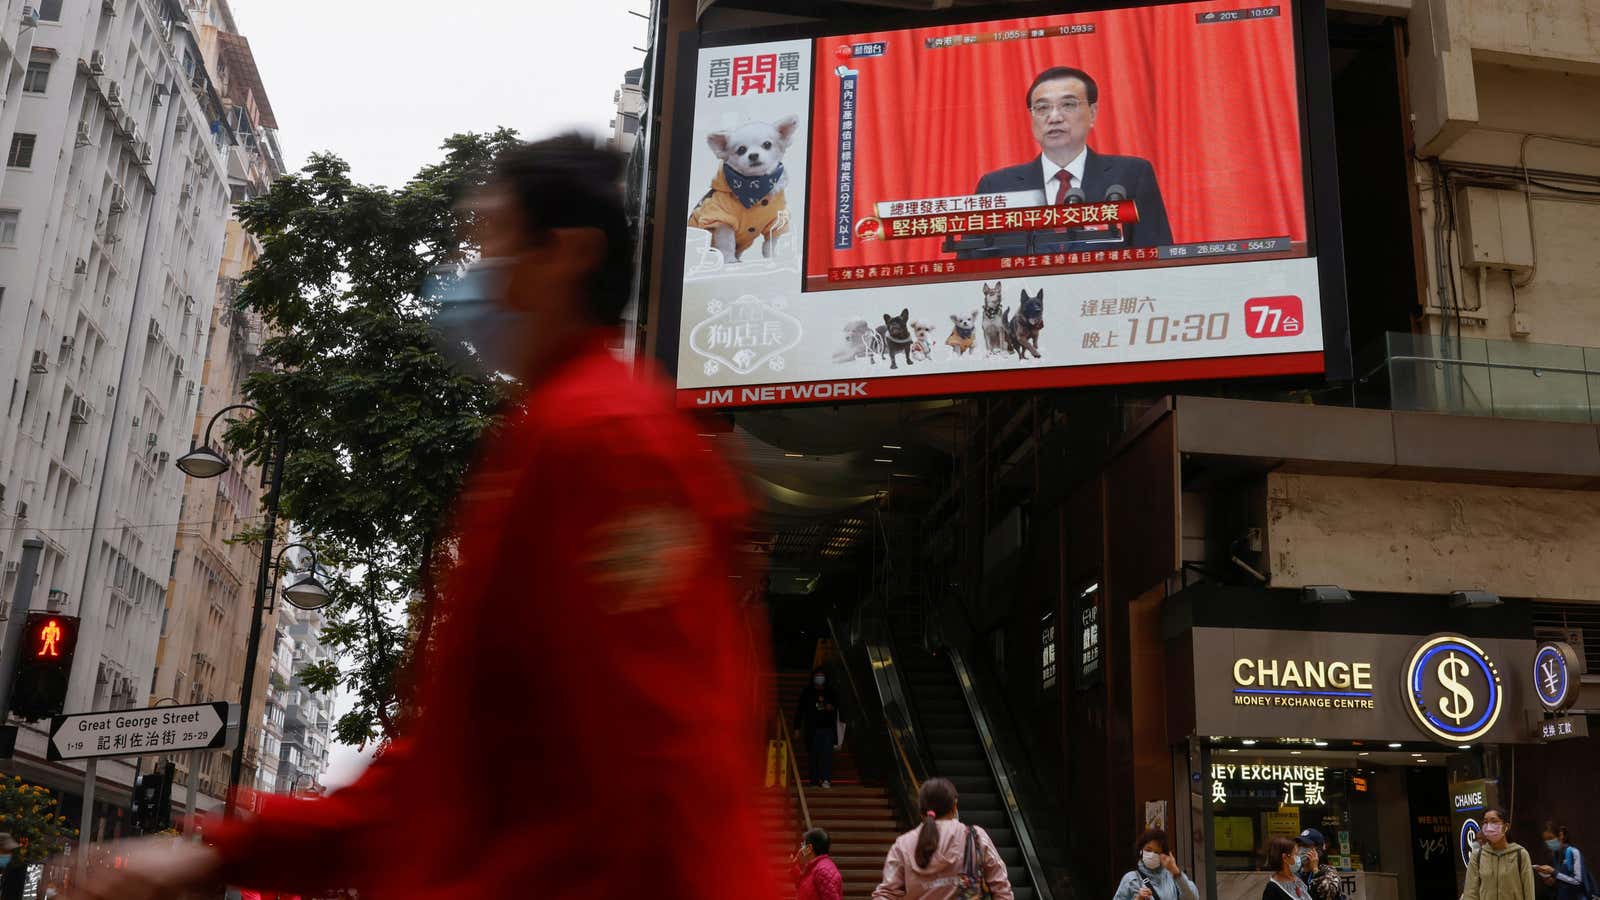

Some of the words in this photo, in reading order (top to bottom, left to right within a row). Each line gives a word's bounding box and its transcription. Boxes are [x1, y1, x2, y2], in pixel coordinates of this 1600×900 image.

[1251, 8, 1274, 17] 10:02
[778, 52, 800, 92] 電視
[890, 194, 1007, 216] 總理發表工作報告
[892, 204, 1119, 237] 堅持獨立自主和平外交政策
[1247, 240, 1276, 250] 554.37
[1080, 296, 1157, 317] 逢星期六
[1081, 330, 1119, 349] 晚上
[1127, 312, 1230, 346] 10:30
[1250, 305, 1299, 334] 77台
[707, 320, 783, 349] 狗店長
[696, 389, 733, 405] JM
[741, 382, 868, 402] NETWORK
[1233, 658, 1373, 690] CHANGE
[1234, 695, 1271, 706] MONEY
[1333, 699, 1374, 709] CENTRE
[78, 719, 111, 732] Great
[115, 716, 158, 729] George
[162, 711, 200, 725] Street
[97, 730, 176, 751] 記利佐治街
[182, 731, 208, 742] 25-29
[1241, 765, 1325, 781] EXCHANGE
[1283, 781, 1326, 805] 汇款
[1454, 791, 1483, 808] CHANGE
